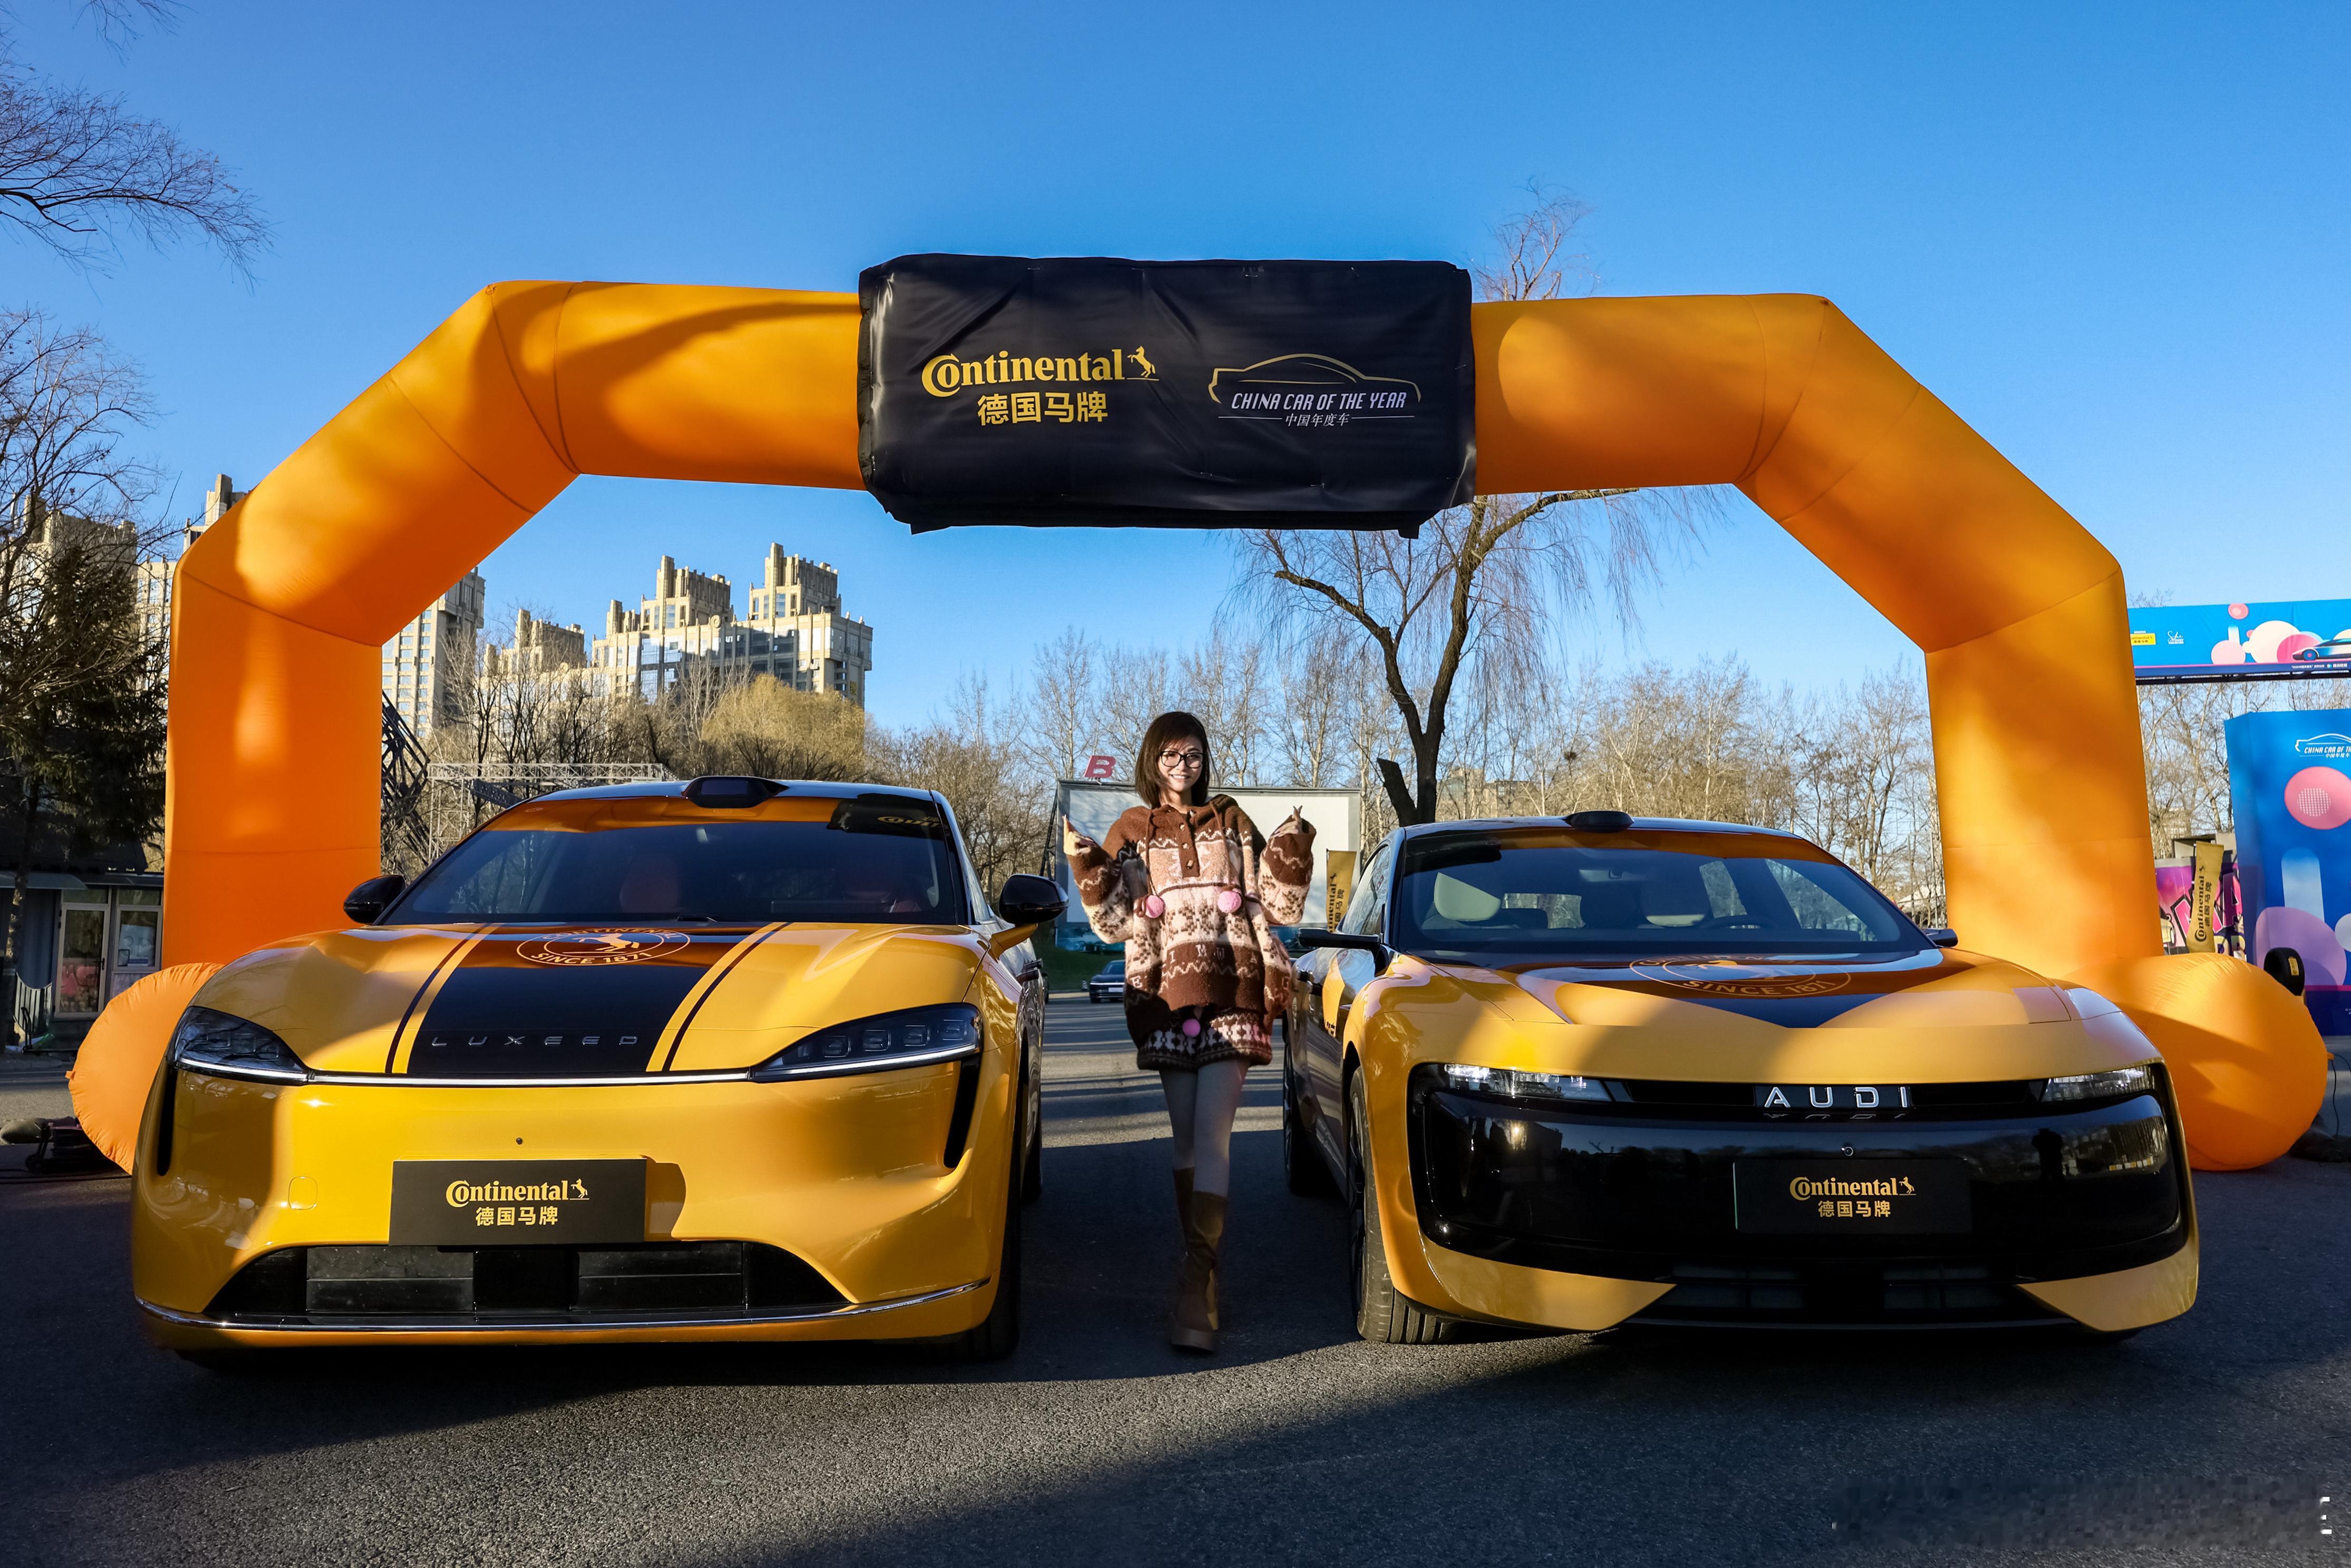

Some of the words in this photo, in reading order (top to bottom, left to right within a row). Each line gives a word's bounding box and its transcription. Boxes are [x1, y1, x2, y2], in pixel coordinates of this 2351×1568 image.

[921, 349, 1125, 398] Continental
[977, 391, 1108, 426] 德国马牌
[1231, 393, 1281, 410] CHINA
[1283, 393, 1314, 410] CAR
[1318, 393, 1337, 410] OF
[1338, 393, 1367, 410] THE
[1369, 392, 1407, 409] YEAR
[1284, 413, 1350, 427] 中国年度车
[2194, 876, 2207, 942] Continental
[530, 952, 595, 964] SINCE
[603, 952, 652, 963] 1871
[1683, 980, 1781, 995] SINCE
[1785, 980, 1836, 993] 1871
[431, 1035, 638, 1046] LUXEED
[1764, 1086, 1908, 1108] AUDI
[446, 1179, 569, 1207] Continental
[1789, 1176, 1899, 1201] Continental
[475, 1206, 558, 1226] 德国马牌
[1818, 1201, 1891, 1217] 德国马牌
